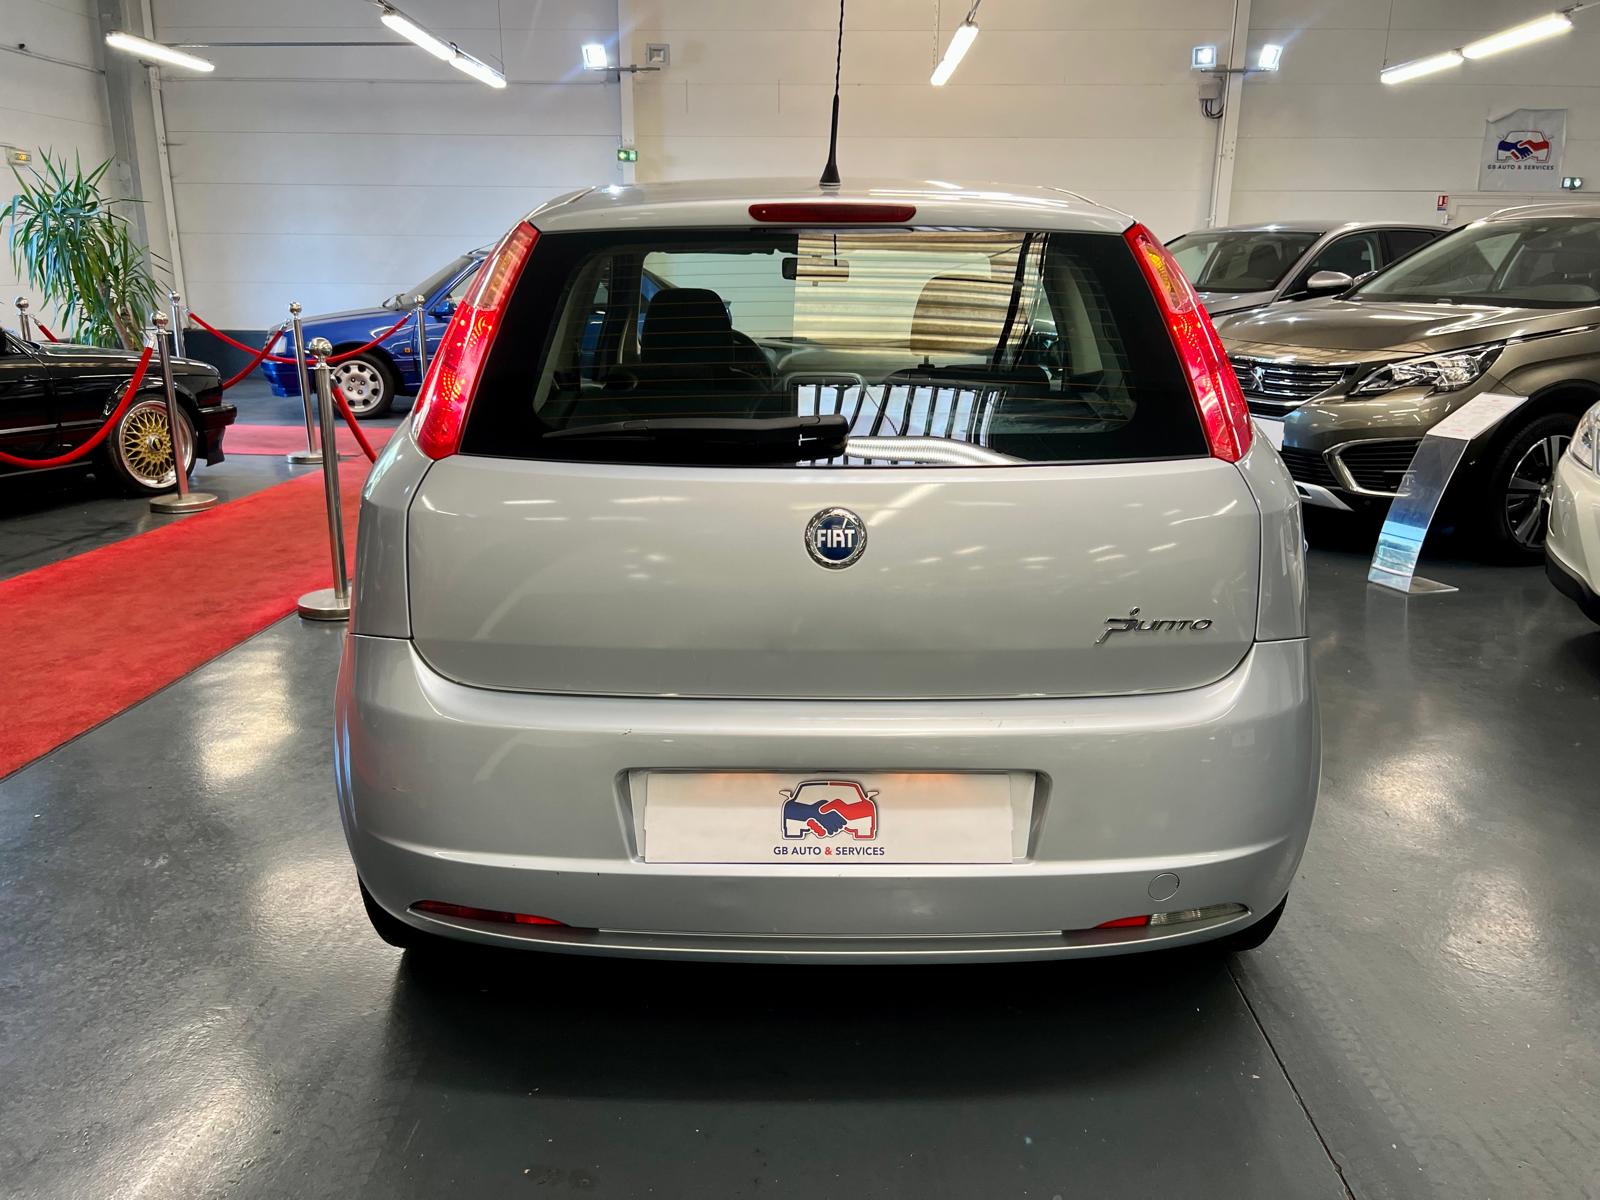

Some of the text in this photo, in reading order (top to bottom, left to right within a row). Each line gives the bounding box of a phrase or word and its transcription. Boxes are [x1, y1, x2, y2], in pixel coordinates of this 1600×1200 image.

[816, 528, 856, 549] FIAT
[773, 846, 885, 856] GB AUTO & SERVICES
